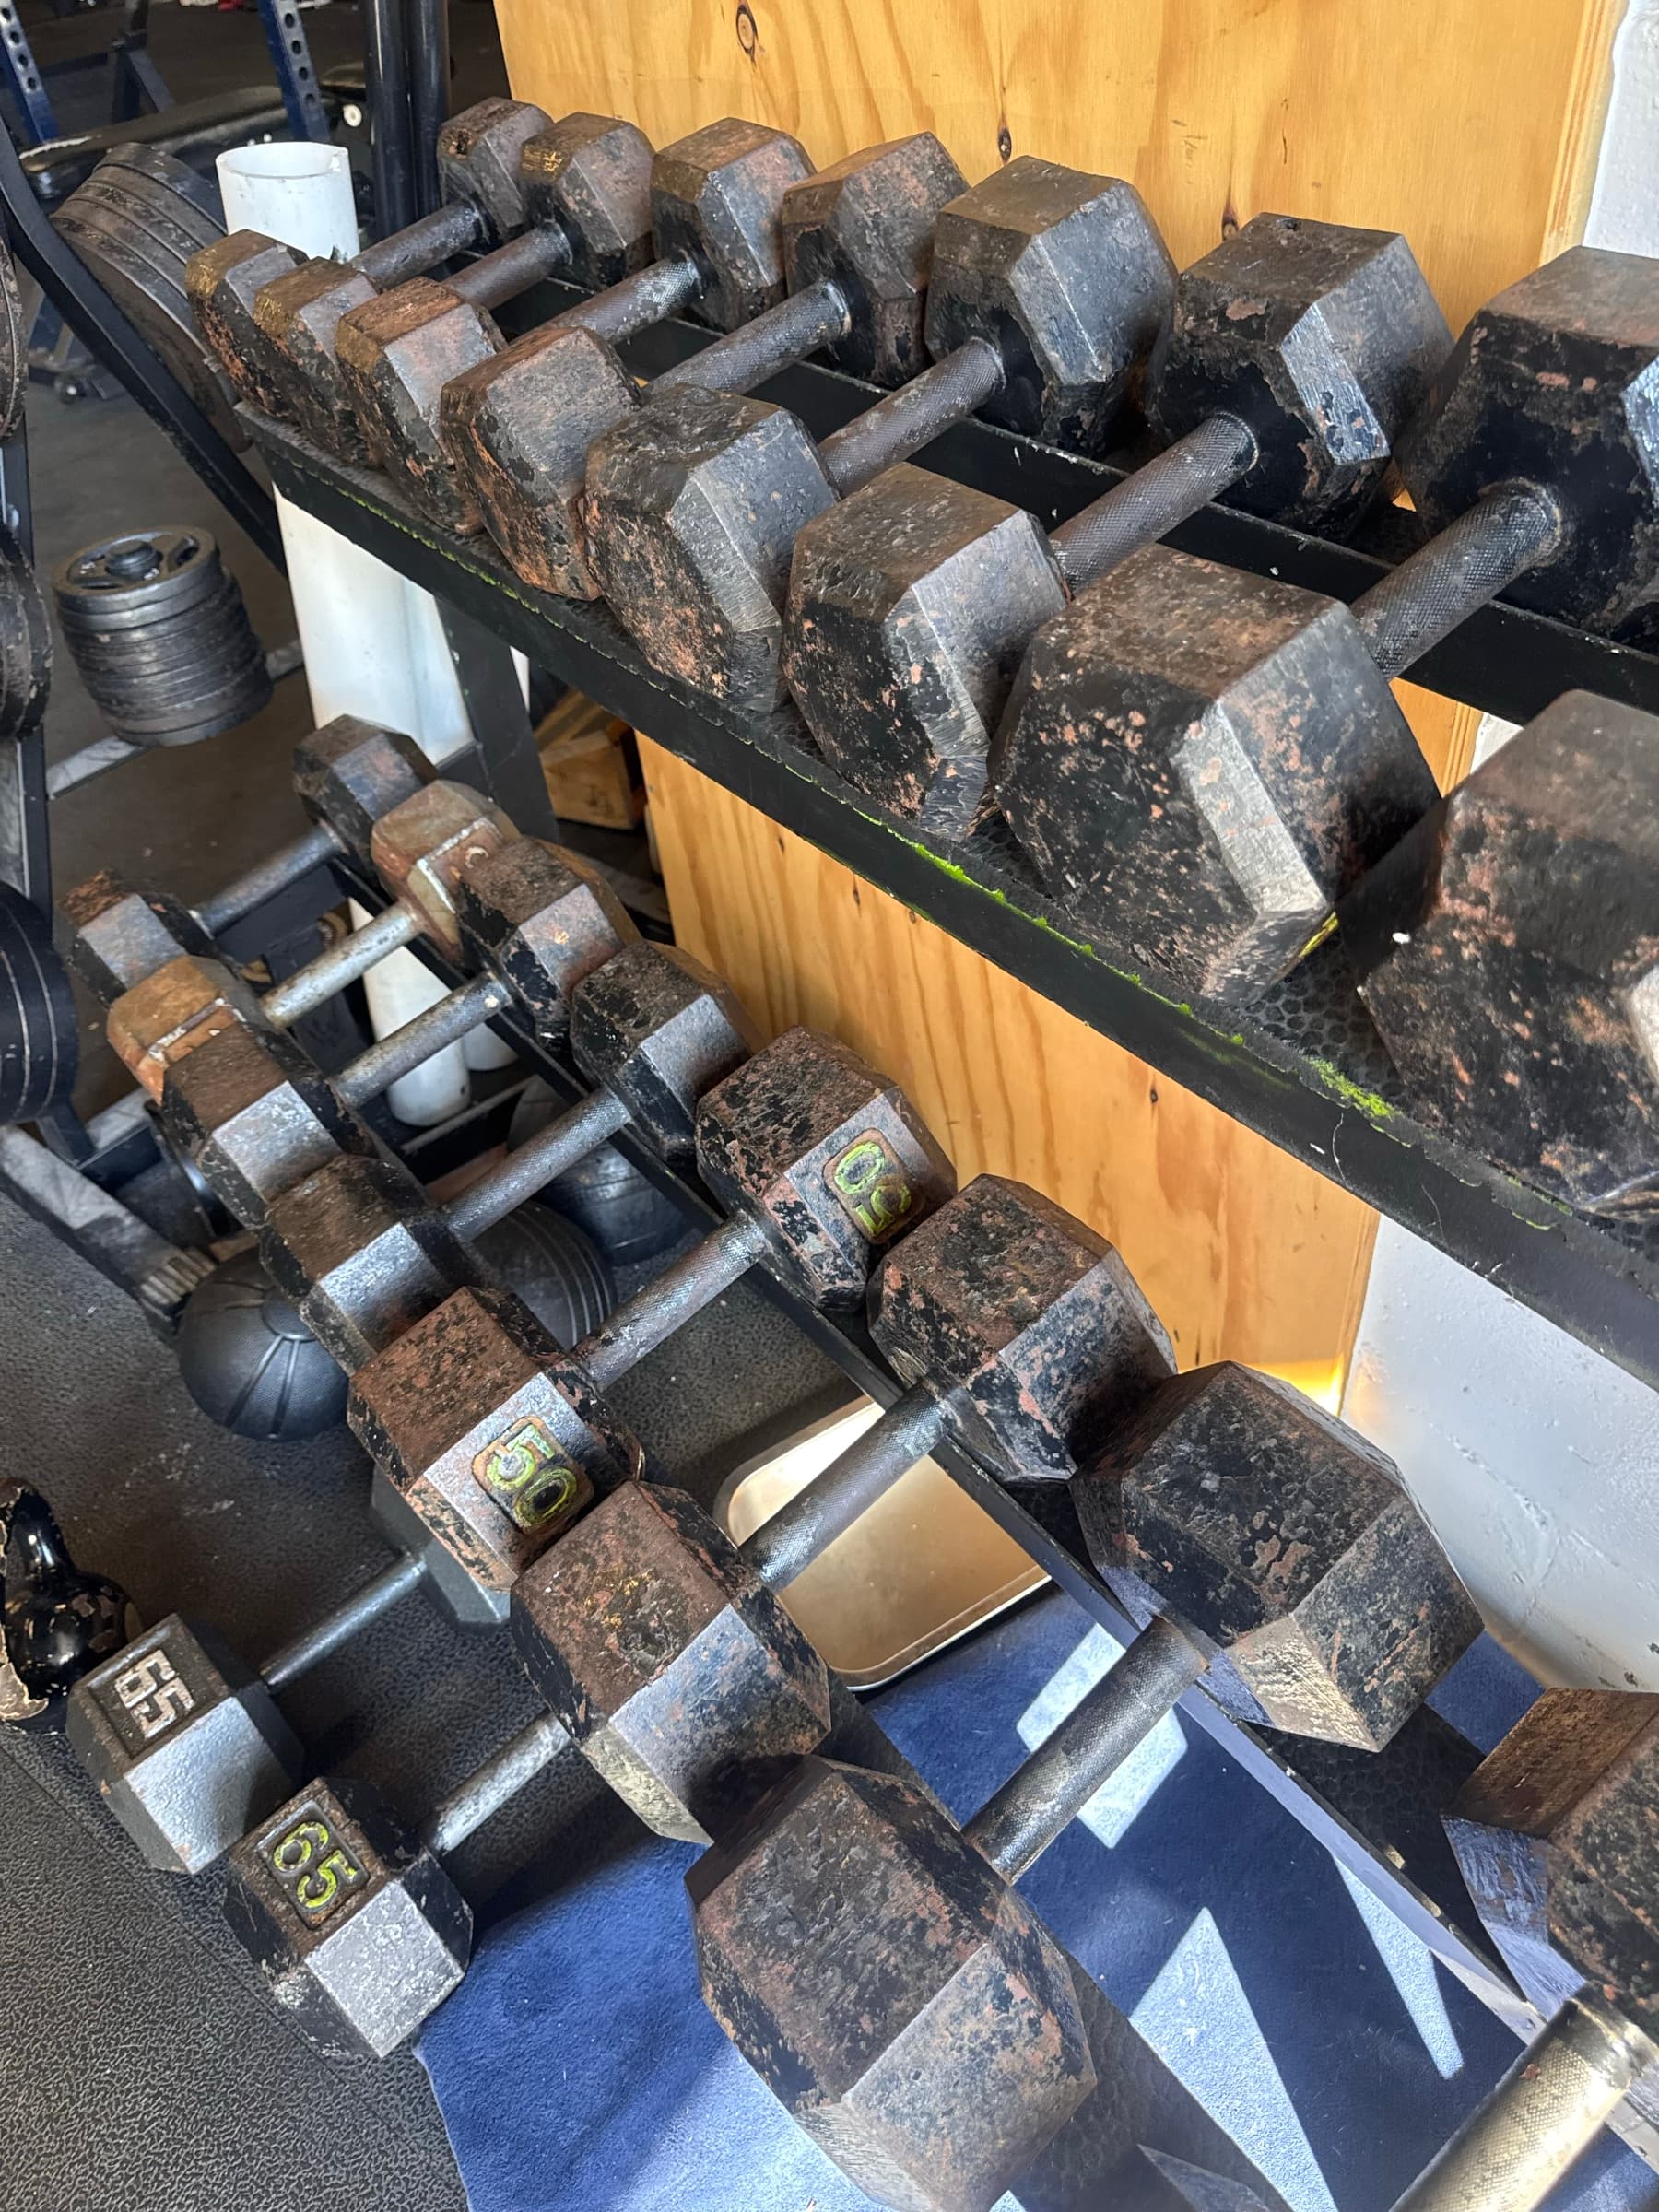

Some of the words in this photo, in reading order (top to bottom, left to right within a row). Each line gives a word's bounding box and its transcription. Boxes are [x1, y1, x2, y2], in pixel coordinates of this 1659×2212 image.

[834, 1140, 912, 1236] 50
[485, 1422, 578, 1528] 50
[113, 1649, 196, 1739] 65
[273, 1821, 359, 1909] 65
